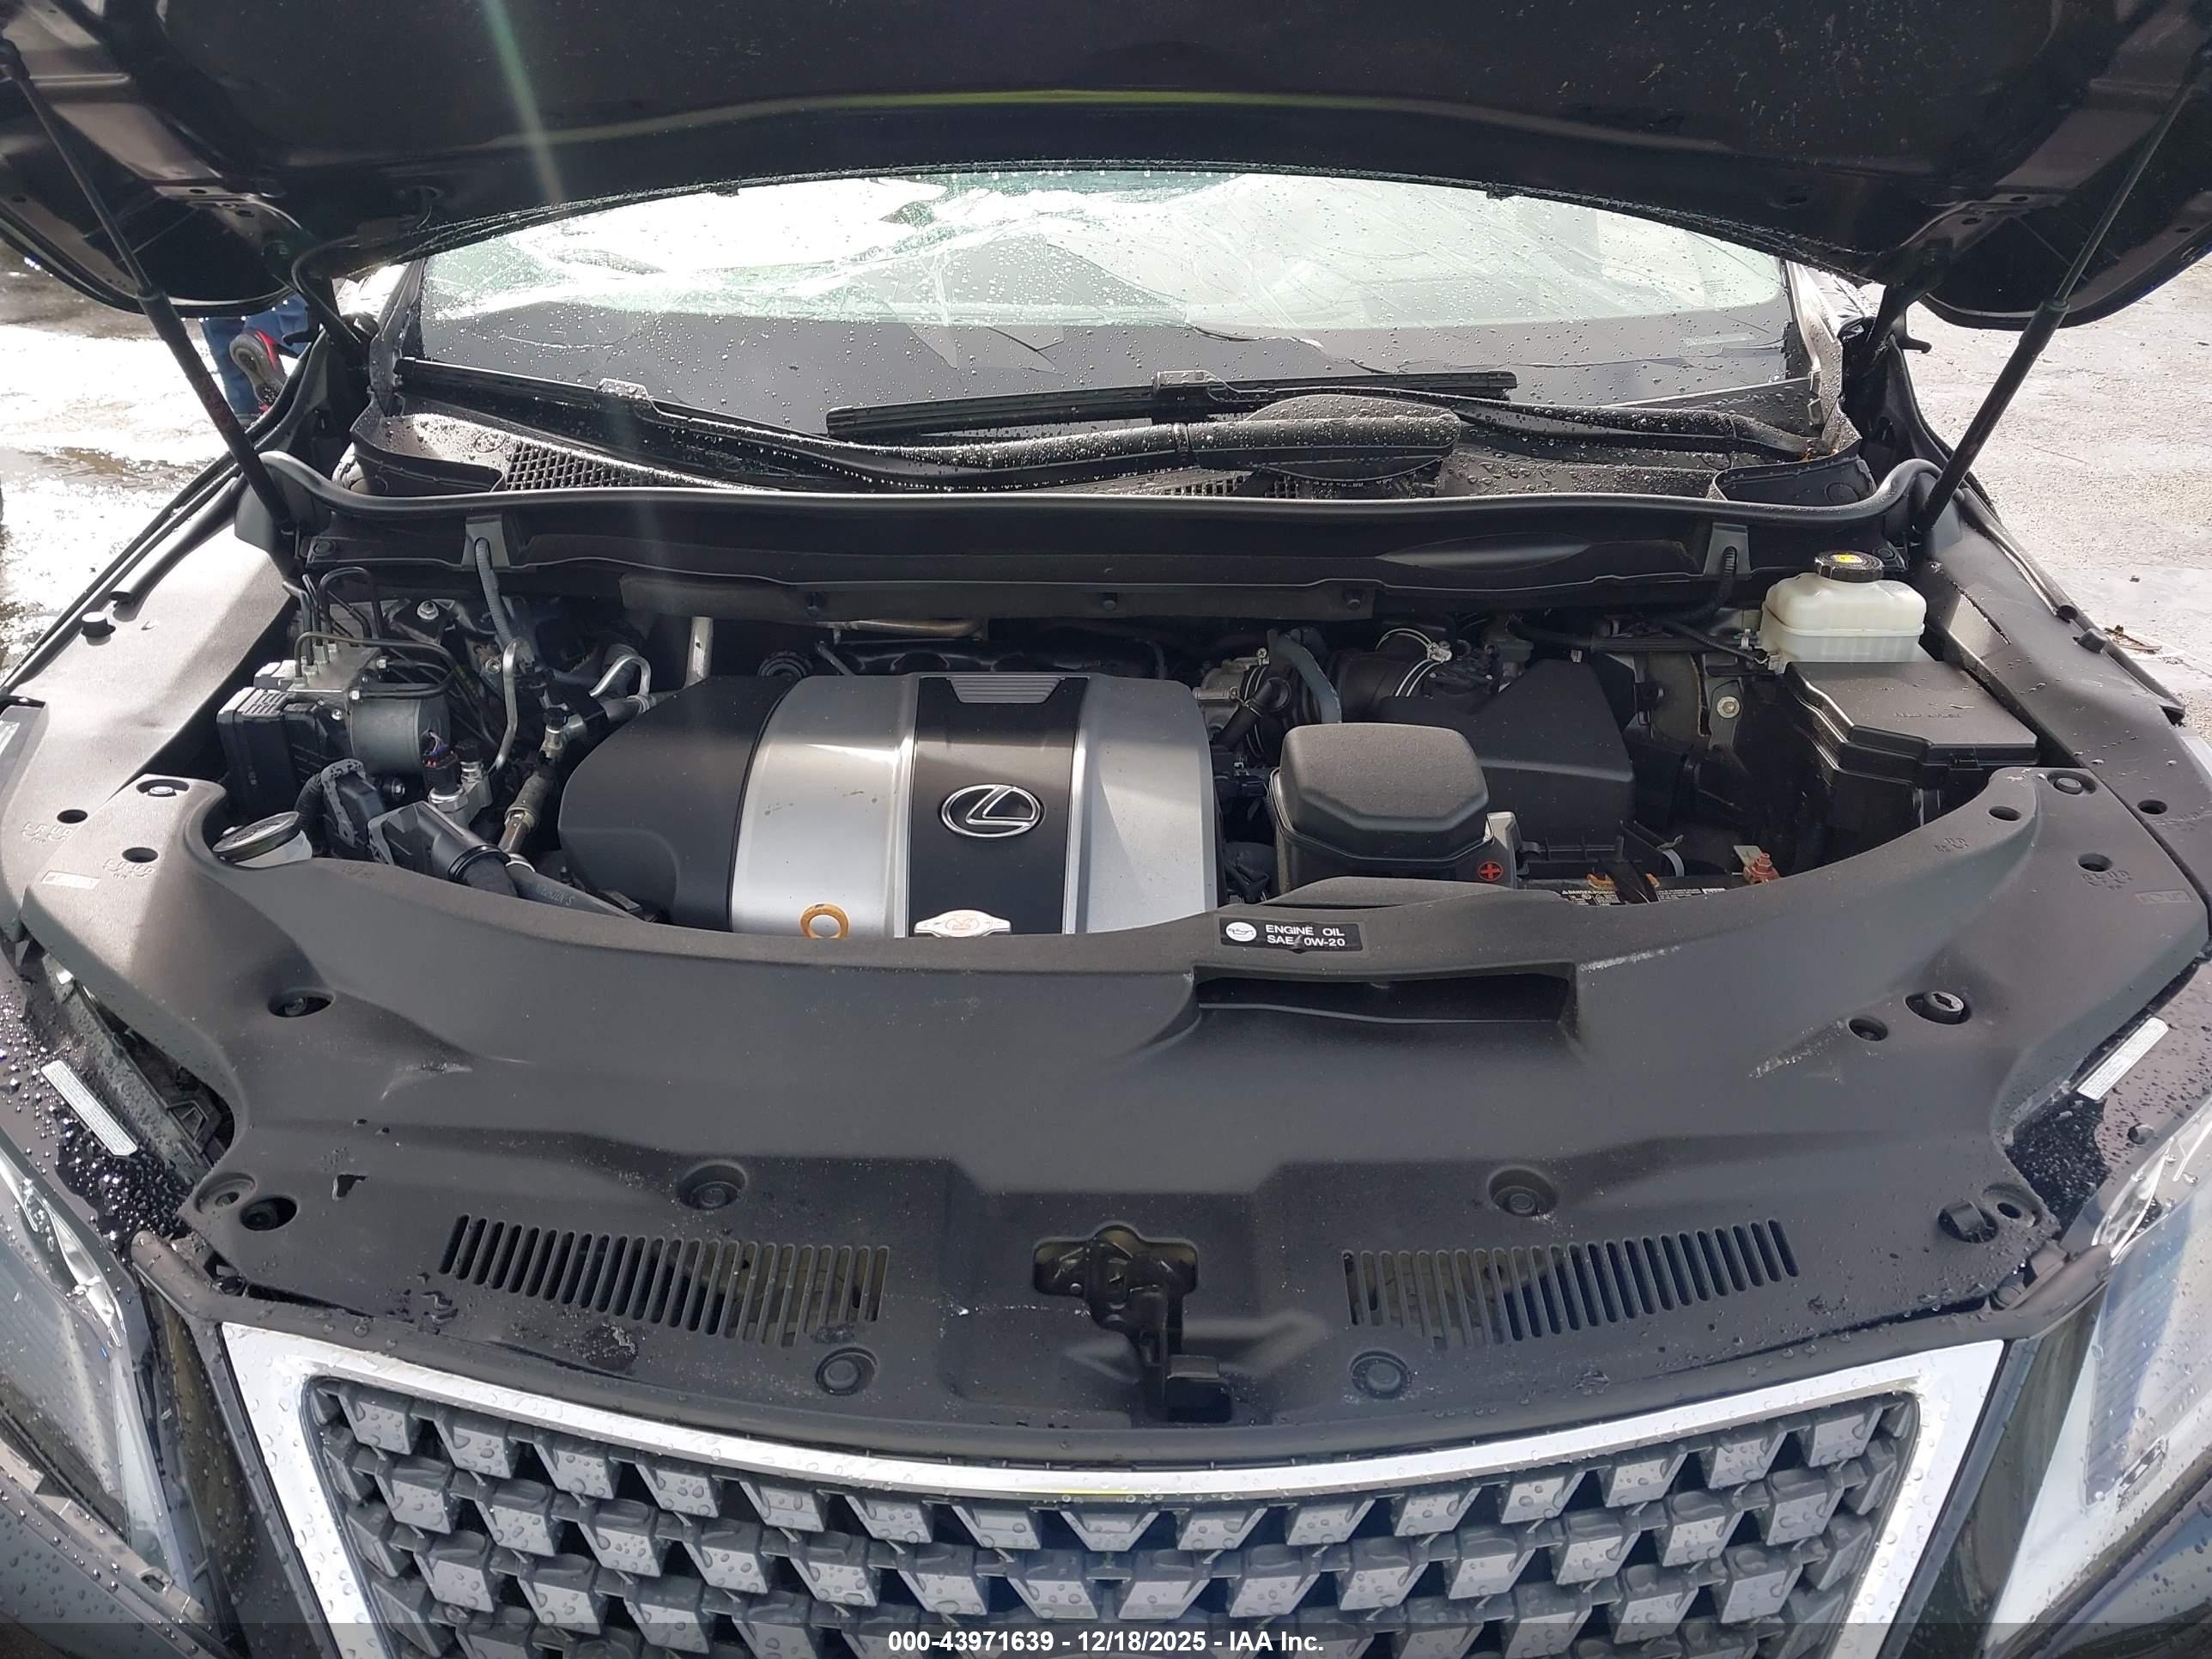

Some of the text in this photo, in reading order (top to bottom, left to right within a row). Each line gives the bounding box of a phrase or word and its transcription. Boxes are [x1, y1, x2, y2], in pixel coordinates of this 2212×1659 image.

[1265, 925, 1345, 937] ENGINE OIL
[1267, 934, 1346, 947] SAE 0W-20
